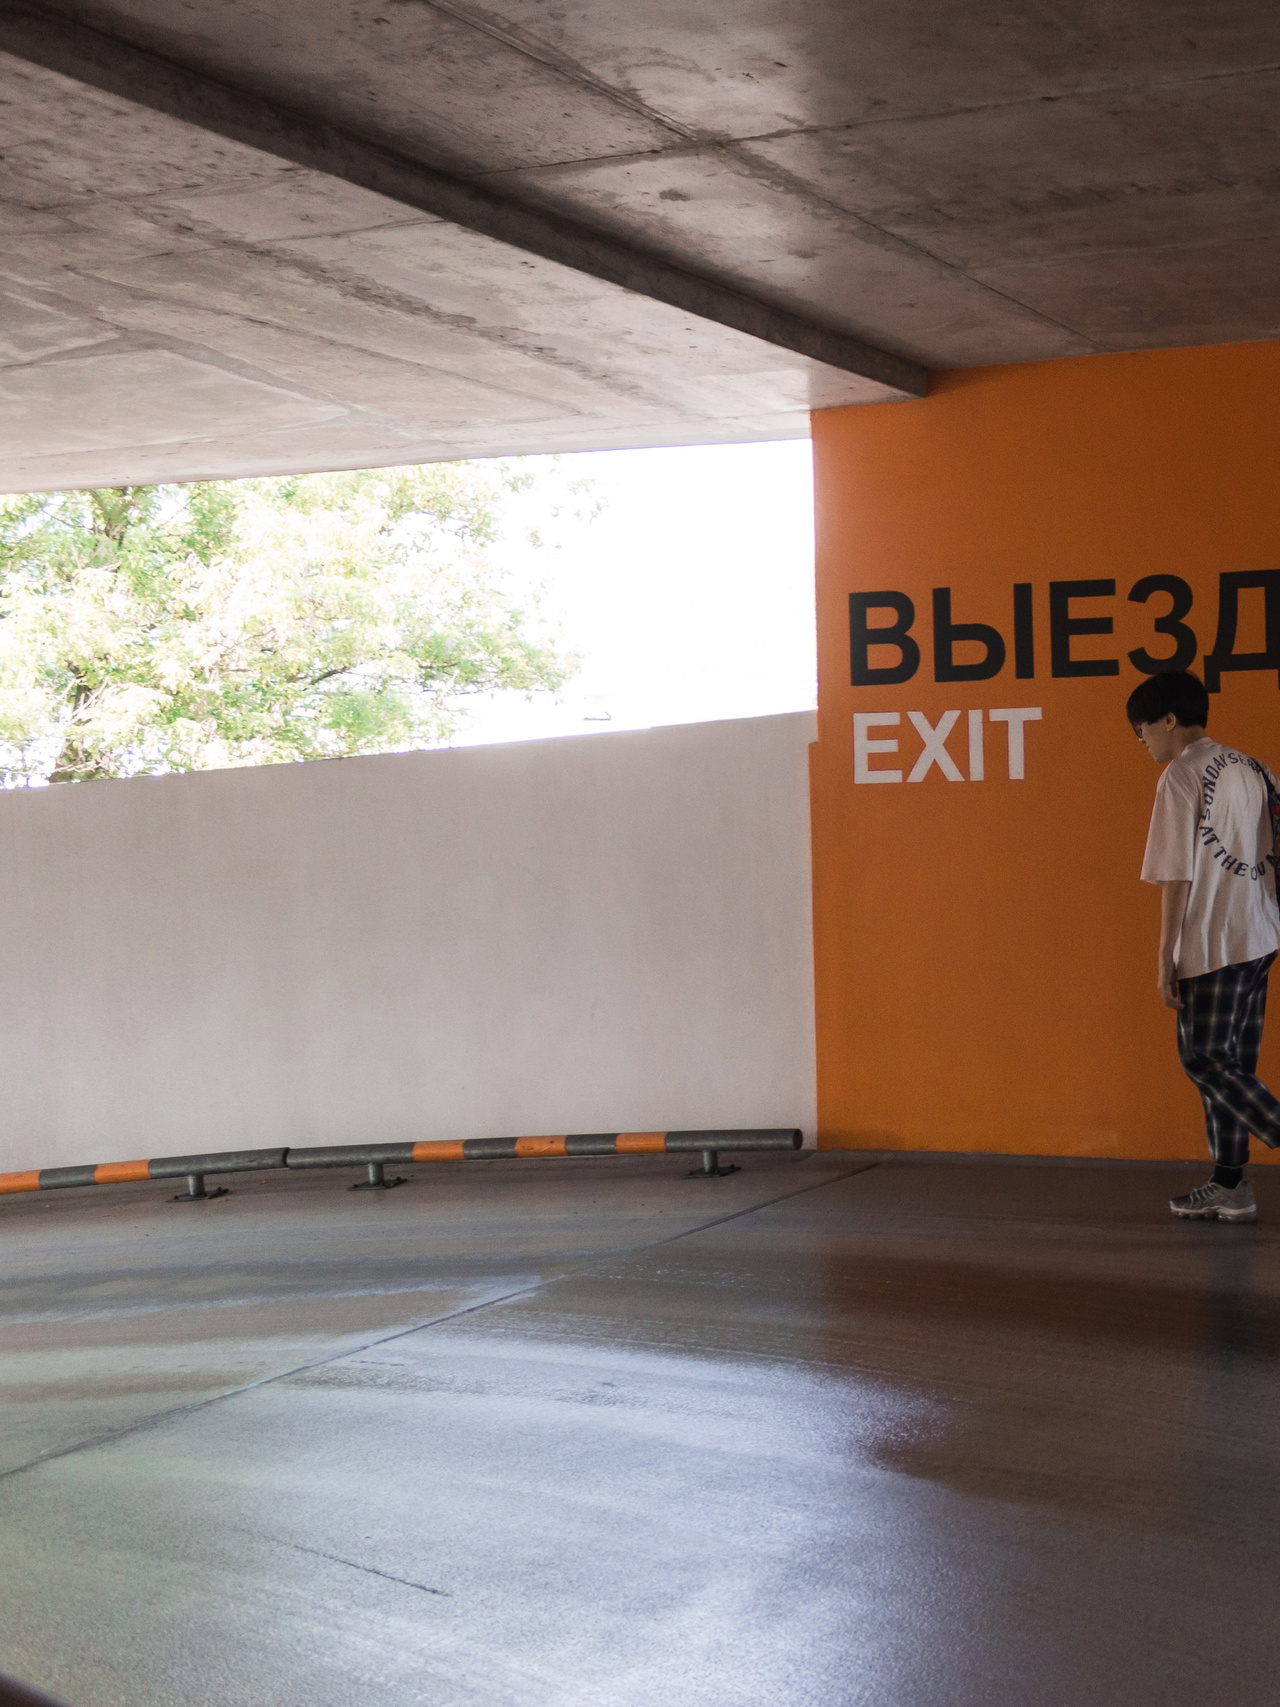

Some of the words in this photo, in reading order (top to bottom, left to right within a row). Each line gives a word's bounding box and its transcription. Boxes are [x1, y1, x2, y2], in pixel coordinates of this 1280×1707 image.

[853, 707, 1043, 785] EXIT
[1199, 826, 1220, 846] AT
[1213, 845, 1249, 877] THE
